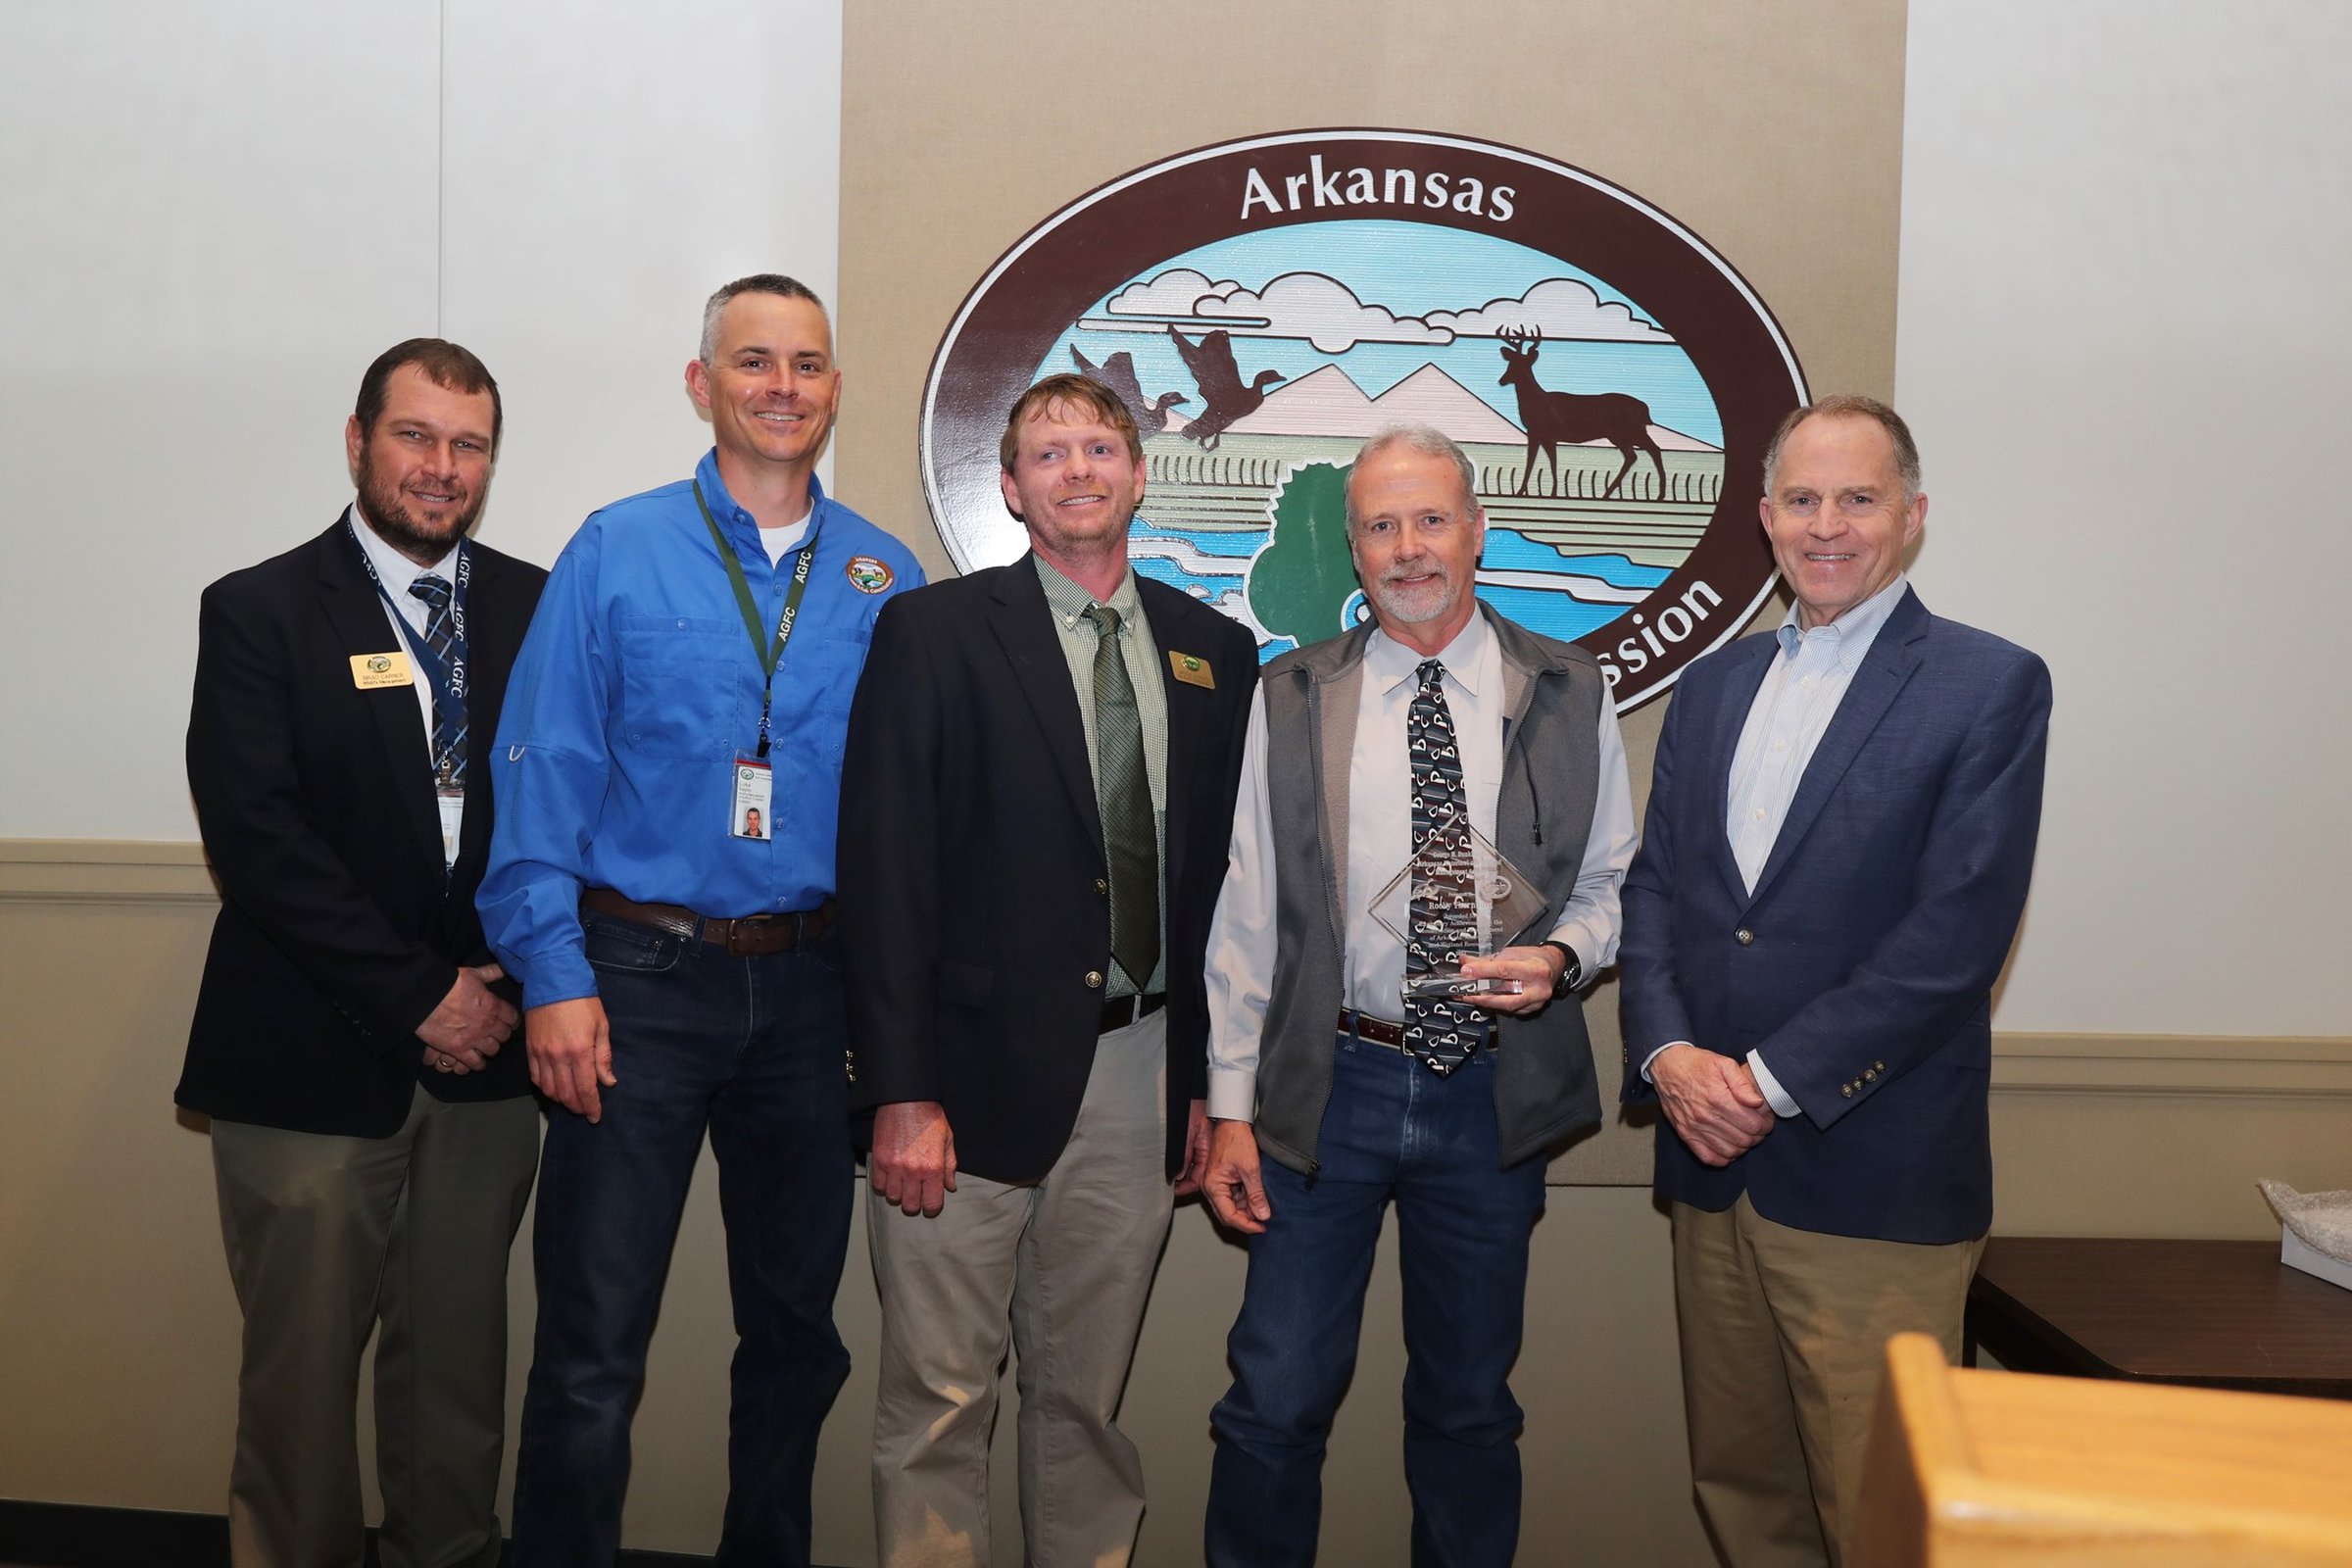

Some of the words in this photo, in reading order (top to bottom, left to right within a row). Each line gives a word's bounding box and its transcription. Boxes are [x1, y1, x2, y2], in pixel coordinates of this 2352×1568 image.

[1241, 154, 1516, 221] Arkansas
[457, 551, 470, 588] AGFC
[795, 551, 812, 584] AGFC
[455, 602, 465, 642] AGFC
[778, 607, 796, 642] AGFC
[451, 656, 465, 698] AGFC
